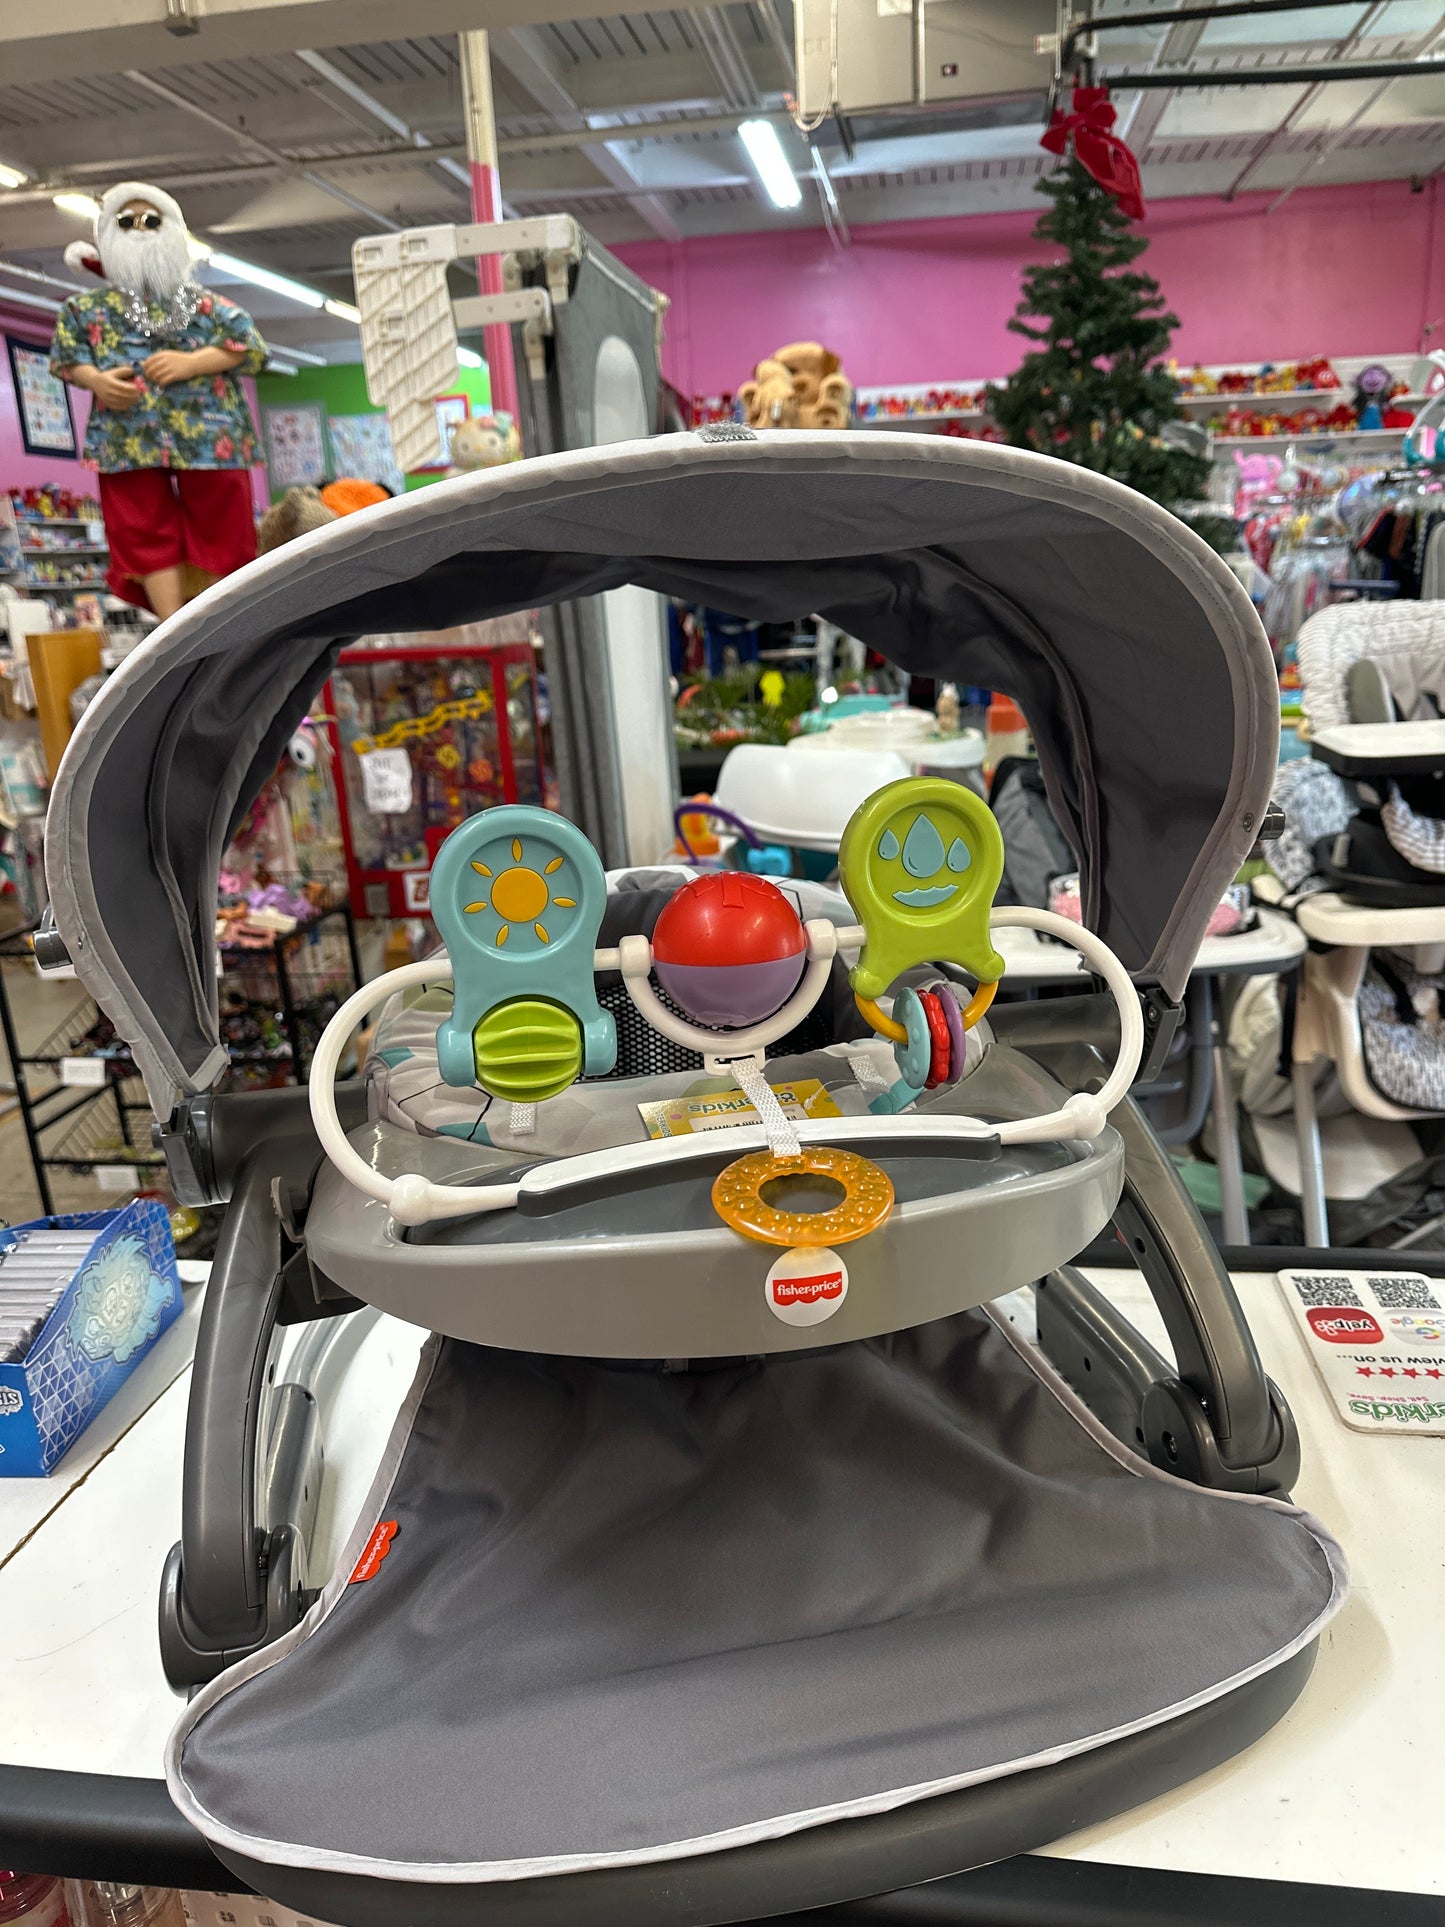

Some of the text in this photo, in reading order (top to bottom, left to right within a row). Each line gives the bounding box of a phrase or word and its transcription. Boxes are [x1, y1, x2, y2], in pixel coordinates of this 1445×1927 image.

[688, 1092, 796, 1114] cerkids
[656, 1111, 673, 1137] TERKIDS
[1333, 1318, 1374, 1331] yelp
[1381, 1355, 1402, 1364] us
